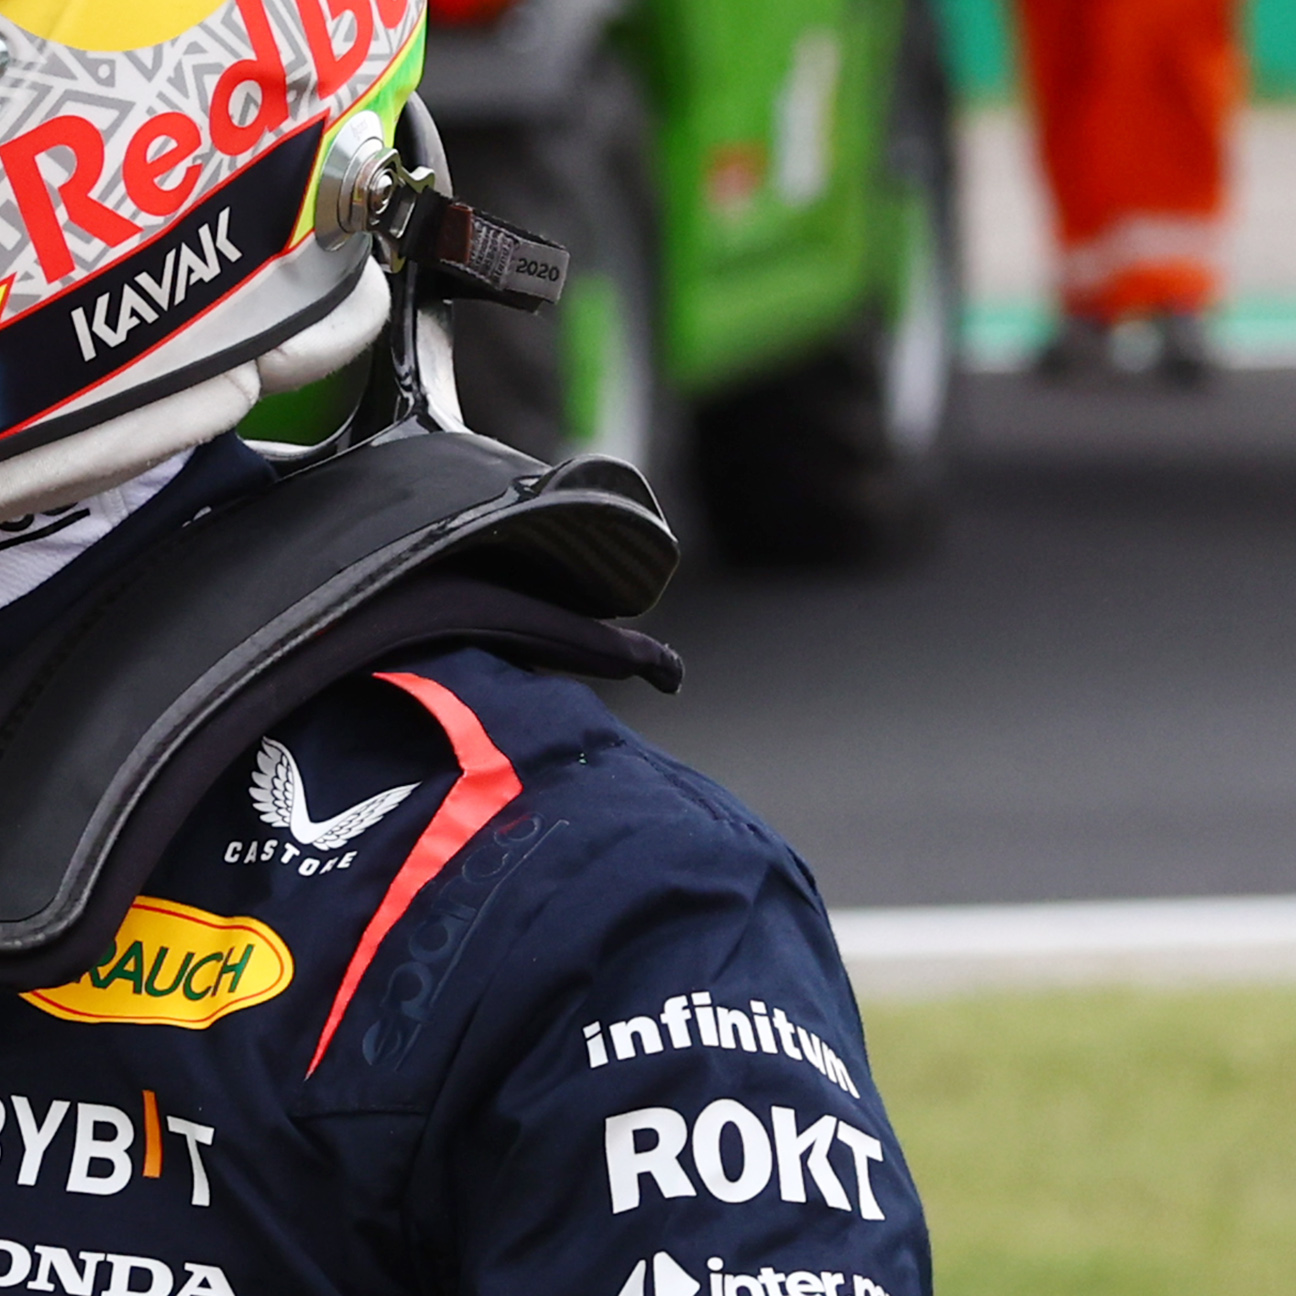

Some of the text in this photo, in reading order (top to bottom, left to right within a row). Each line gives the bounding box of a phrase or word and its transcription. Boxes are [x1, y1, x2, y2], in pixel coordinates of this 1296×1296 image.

[70, 207, 243, 362] KAVAK
[515, 258, 560, 281] 2020
[224, 839, 358, 877] CASTORE
[583, 992, 860, 1099] infinitum
[605, 1098, 885, 1221] ROKT
